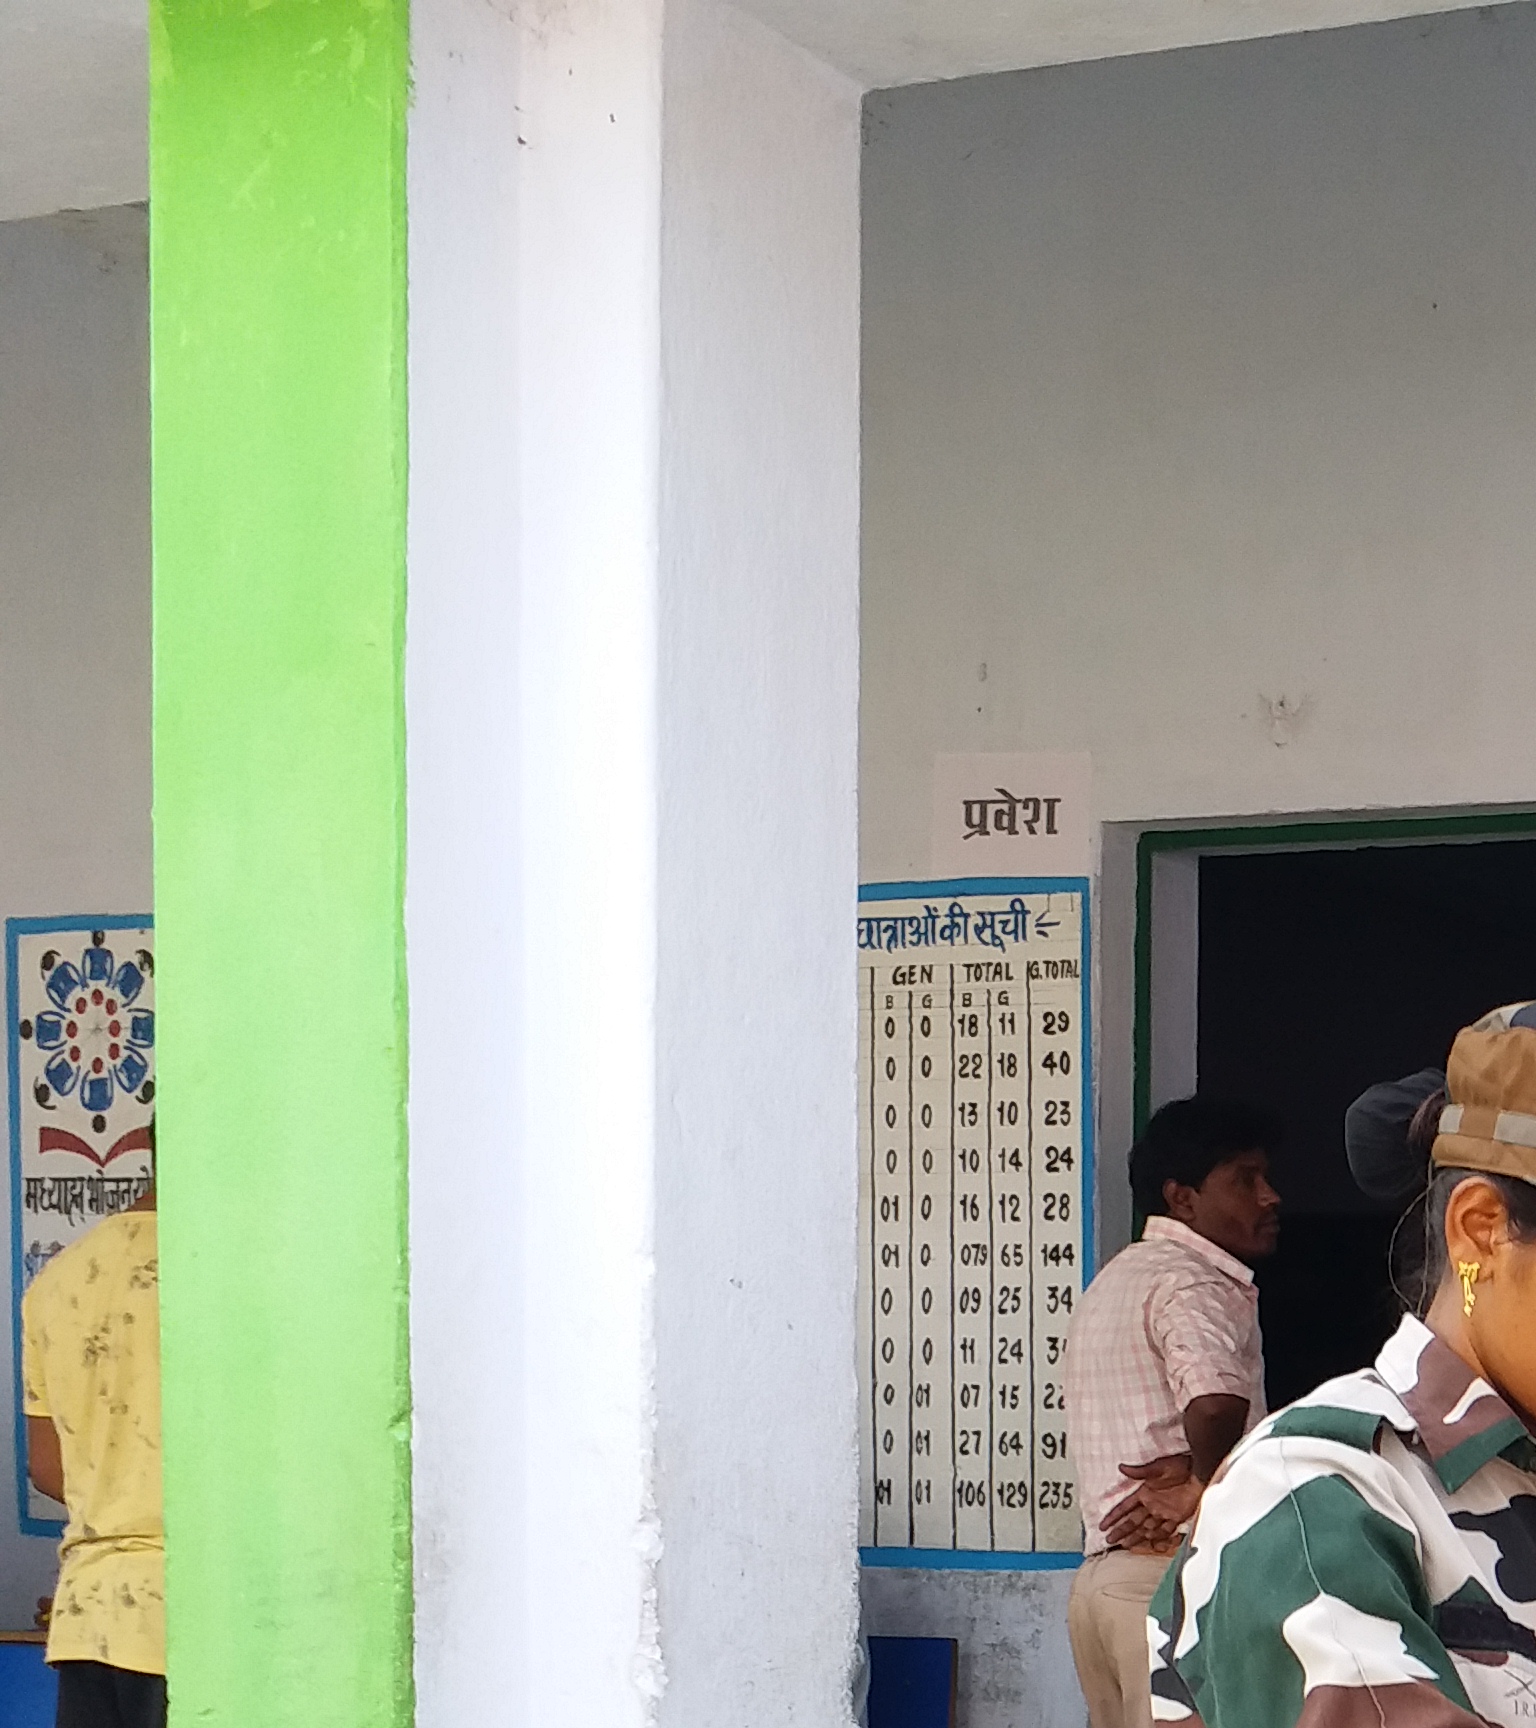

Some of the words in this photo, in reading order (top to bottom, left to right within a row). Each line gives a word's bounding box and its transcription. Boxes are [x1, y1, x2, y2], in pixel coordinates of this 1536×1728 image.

[962, 787, 1061, 841] प्रवेश
[938, 902, 969, 945] की
[974, 898, 1030, 953] सूची
[891, 963, 934, 986] GEN
[961, 961, 1014, 983] TOTAL
[1028, 959, 1080, 981] G.TOTAL
[885, 994, 894, 1010] B
[921, 993, 933, 1009] G
[961, 992, 973, 1008] B
[997, 990, 1010, 1007] G
[884, 1016, 896, 1039] 0
[920, 1015, 932, 1038] 0
[957, 1013, 979, 1038] 18
[998, 1011, 1016, 1036] 11
[1042, 1010, 1070, 1036] 29
[885, 1056, 897, 1081] 0
[921, 1054, 932, 1079] 0
[958, 1052, 983, 1080] 22
[996, 1051, 1018, 1078] 18
[1041, 1050, 1071, 1077] 40
[885, 1104, 897, 1129] 0
[920, 1103, 933, 1129] 0
[957, 1101, 978, 1128] 13
[996, 1100, 1019, 1127] 10
[1044, 1099, 1071, 1127] 23
[885, 1149, 898, 1175] 0
[922, 1148, 933, 1175] 0
[957, 1148, 980, 1174] 10
[997, 1147, 1024, 1174] 14
[1044, 1145, 1074, 1174] 24
[920, 1194, 932, 1222] 0
[959, 1193, 980, 1223] 16
[998, 1192, 1021, 1224] 12
[1042, 1192, 1071, 1222] 28
[920, 1243, 932, 1267] 0
[1000, 1243, 1024, 1268] 65
[1040, 1243, 1075, 1268] 144
[880, 1287, 893, 1316] 0
[921, 1286, 933, 1315] 0
[959, 1286, 982, 1315] 09
[997, 1285, 1022, 1315] 25
[1046, 1285, 1074, 1315] 34
[881, 1336, 895, 1364] 0
[921, 1337, 933, 1366] 0
[959, 1337, 976, 1365] 11
[997, 1336, 1024, 1365] 24
[883, 1383, 896, 1406] 0
[960, 1383, 981, 1409] 07
[998, 1383, 1020, 1410] 15
[882, 1428, 894, 1455] 0
[958, 1429, 982, 1456] 27
[998, 1430, 1024, 1457] 64
[1041, 1431, 1067, 1460] 91
[956, 1479, 986, 1509] 106
[996, 1480, 1028, 1509] 129
[1038, 1480, 1074, 1510] 235
